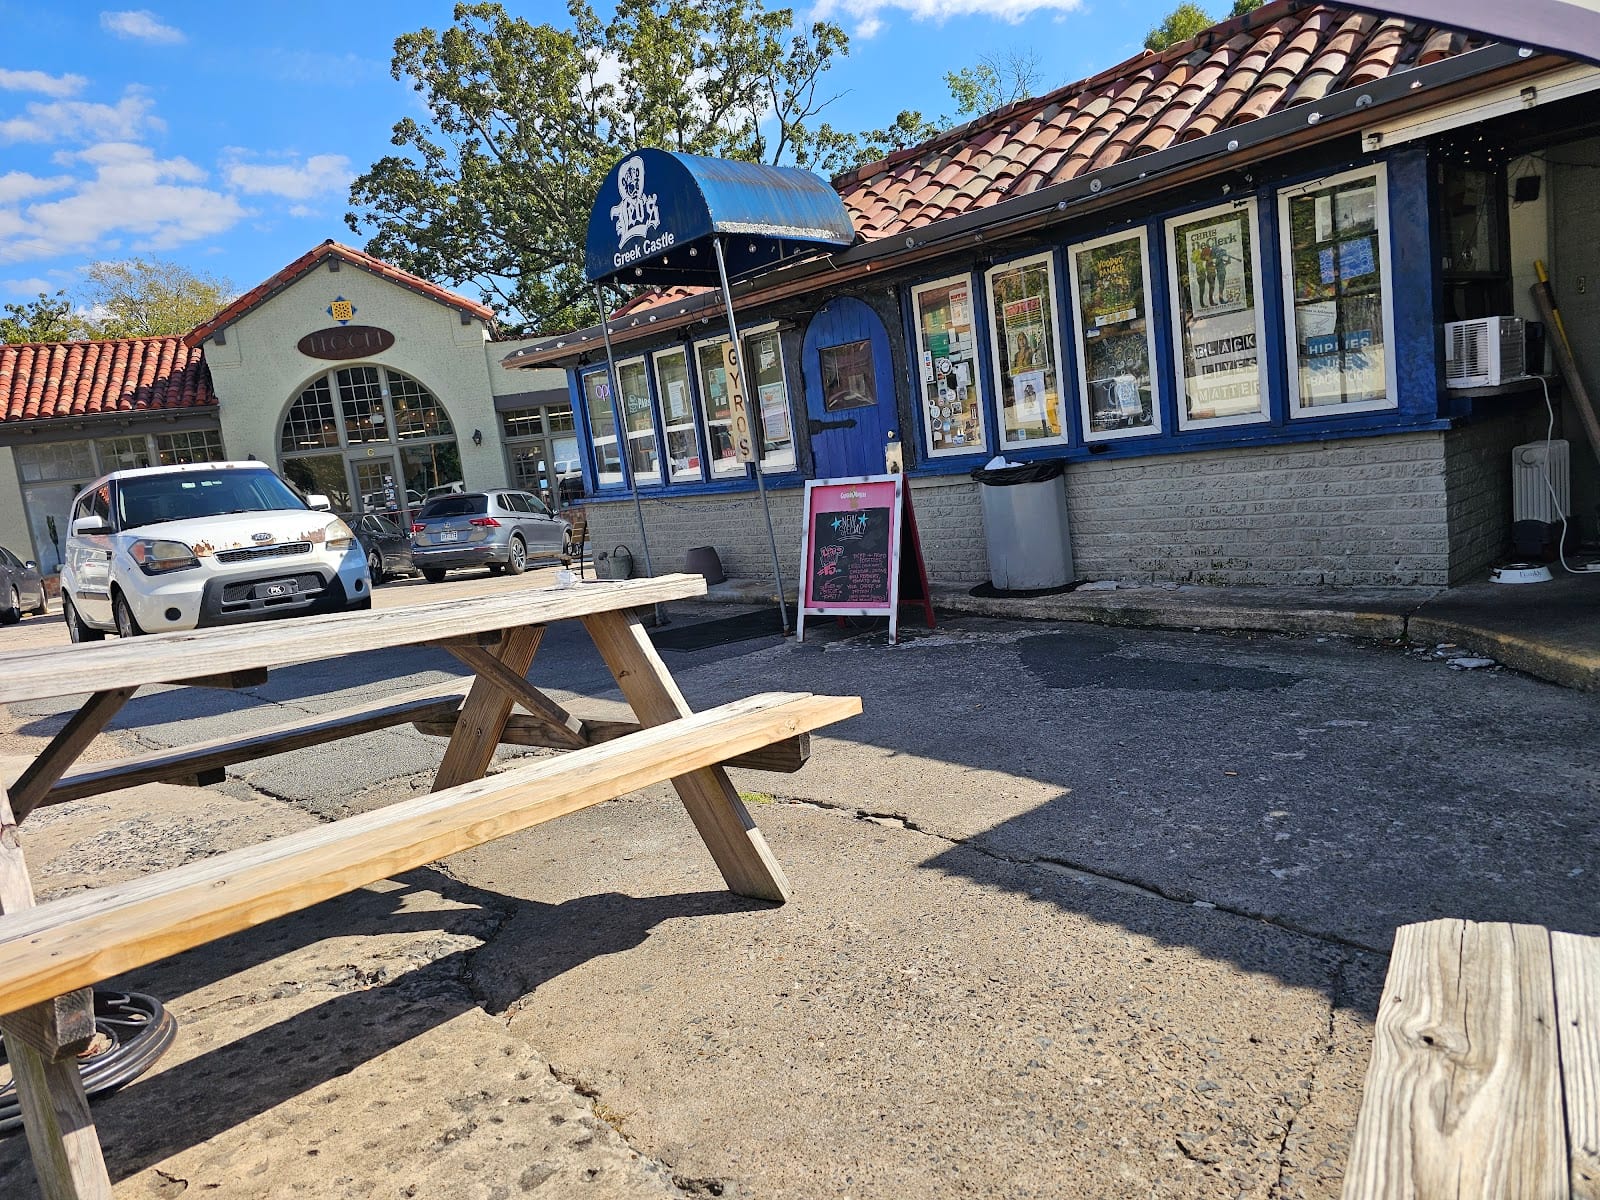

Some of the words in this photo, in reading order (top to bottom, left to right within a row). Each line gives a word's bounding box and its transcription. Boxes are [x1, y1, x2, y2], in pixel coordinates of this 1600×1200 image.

[1191, 229, 1217, 242] CHRIS
[613, 244, 642, 267] Greek
[643, 231, 675, 255] Castle
[1097, 256, 1123, 268] VOODOO
[1196, 334, 1255, 359] BLACK
[1203, 359, 1257, 379] LIVES
[728, 348, 749, 456] GYROS
